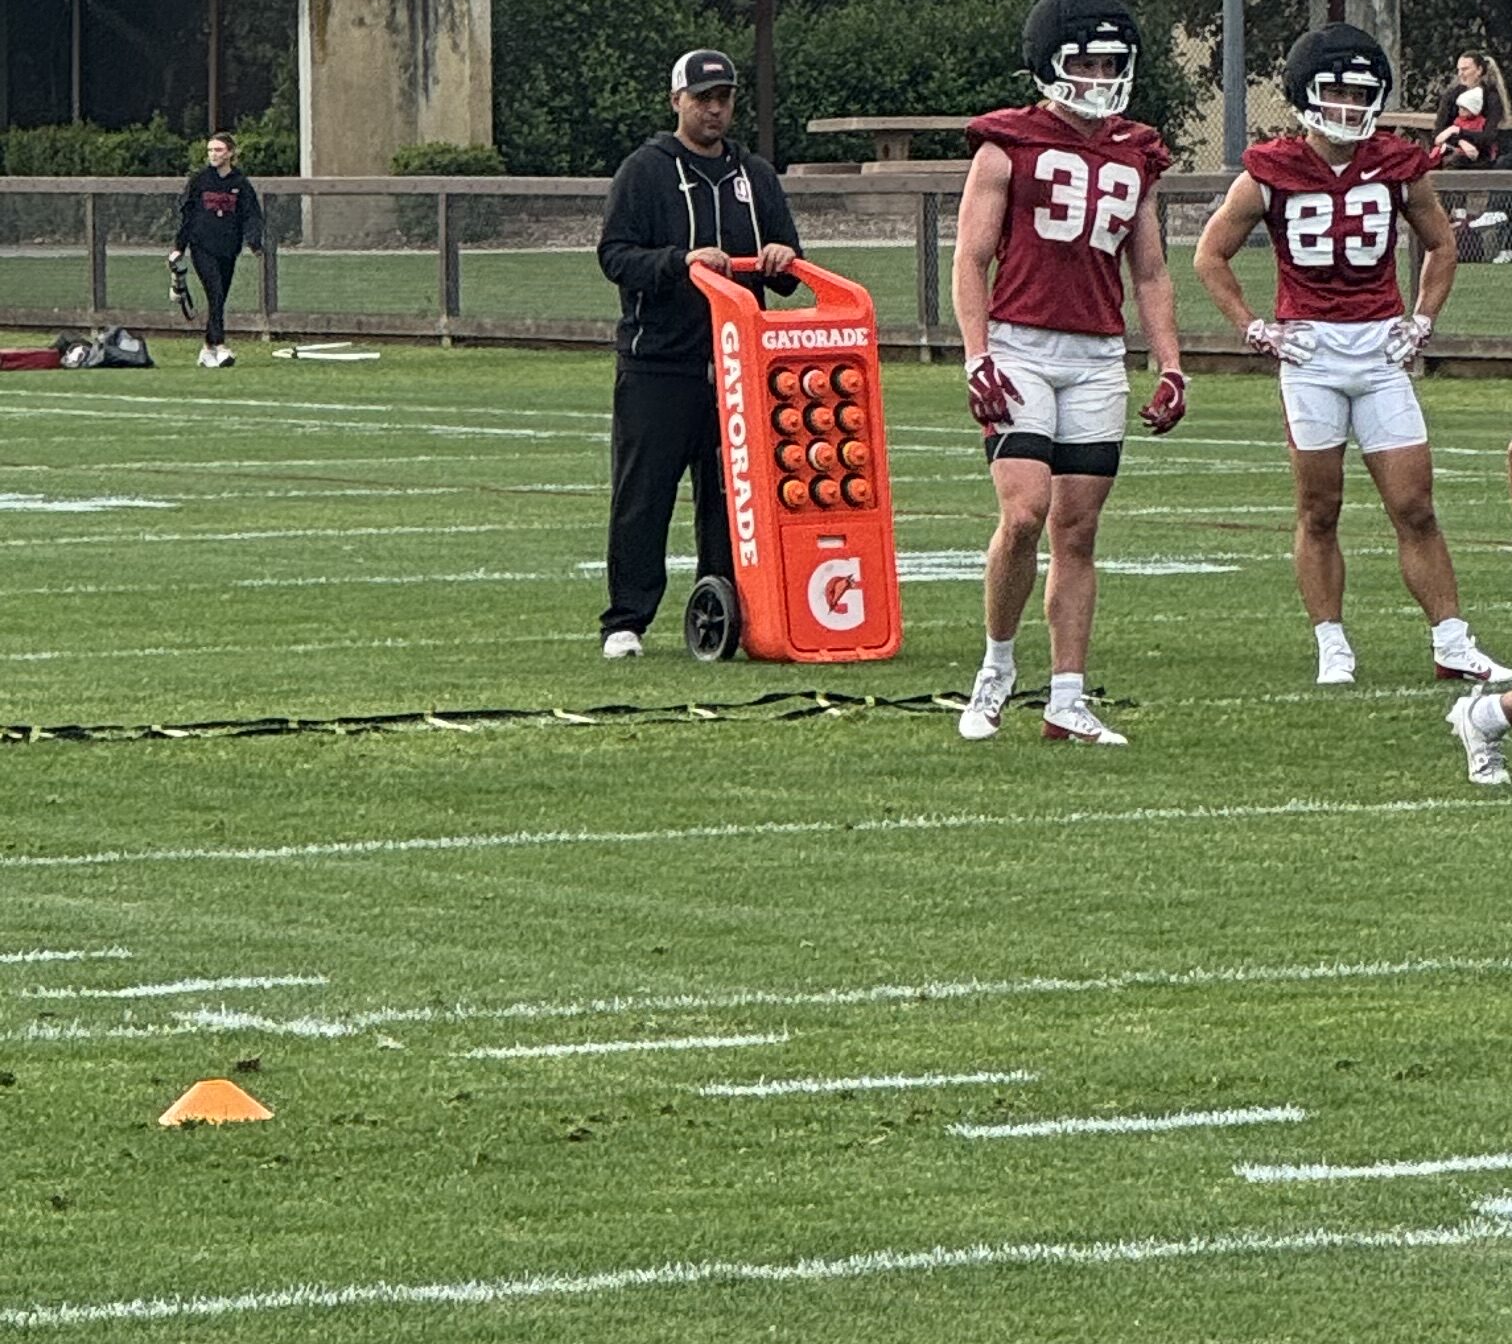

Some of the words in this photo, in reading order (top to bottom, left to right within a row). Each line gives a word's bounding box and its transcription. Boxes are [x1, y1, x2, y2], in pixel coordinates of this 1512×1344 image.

[1034, 149, 1141, 256] 32
[1285, 183, 1392, 266] 23
[762, 327, 869, 350] GATORADE
[721, 321, 758, 567] GATORADE
[807, 557, 865, 631] G
